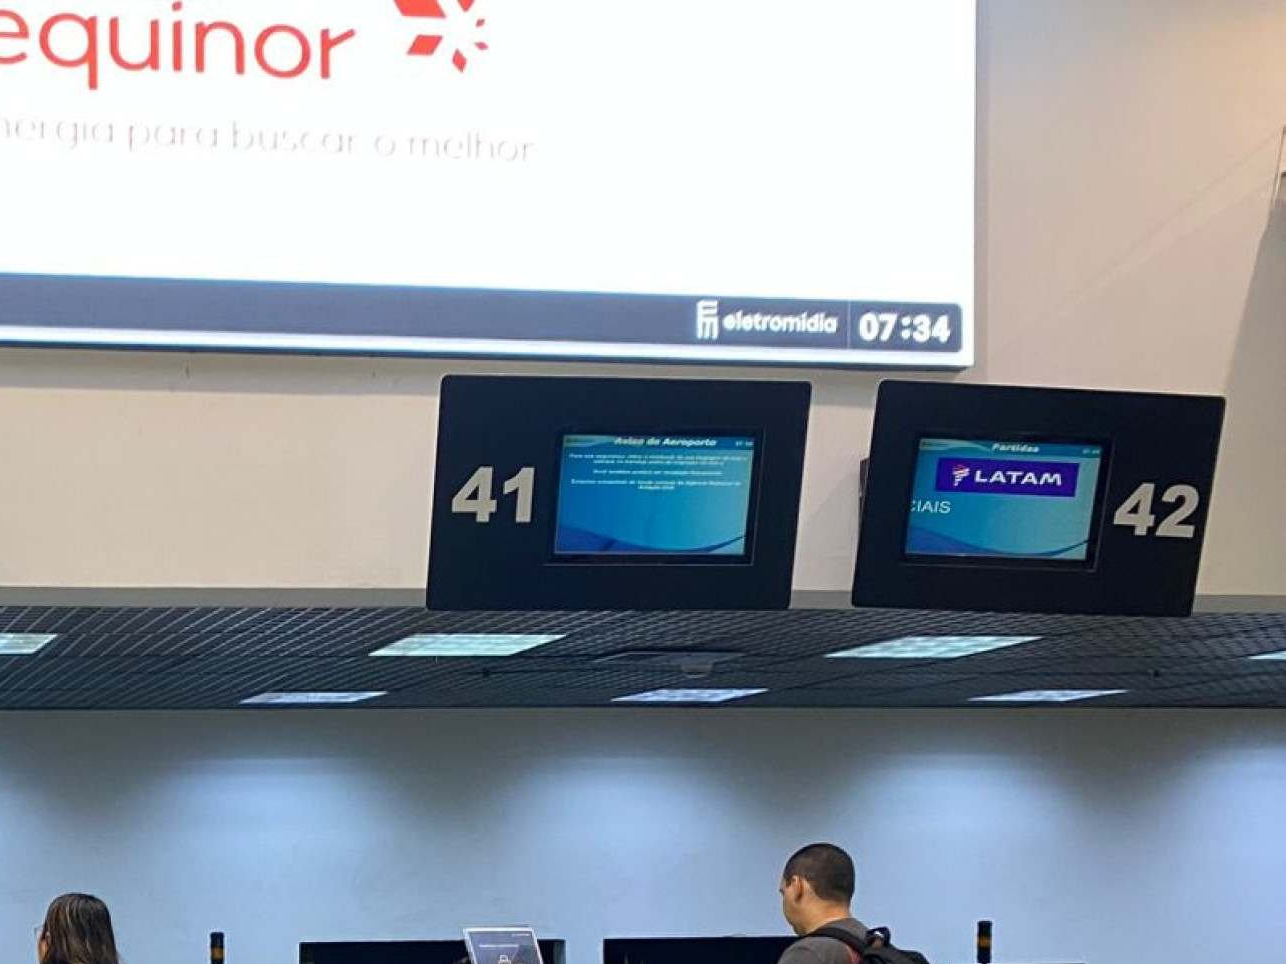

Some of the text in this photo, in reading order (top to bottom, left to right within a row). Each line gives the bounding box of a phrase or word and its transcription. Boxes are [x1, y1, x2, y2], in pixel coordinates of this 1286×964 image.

[128, 120, 218, 152] para
[232, 120, 357, 156] buscar
[373, 135, 397, 158] o
[413, 130, 536, 163] melhor
[858, 311, 951, 343] 07:34
[614, 436, 717, 448] Aviso de Aeroporto
[992, 443, 1040, 453] Partidas
[451, 465, 536, 523] 41
[974, 470, 1062, 487] LATAM
[1113, 483, 1200, 538] 42
